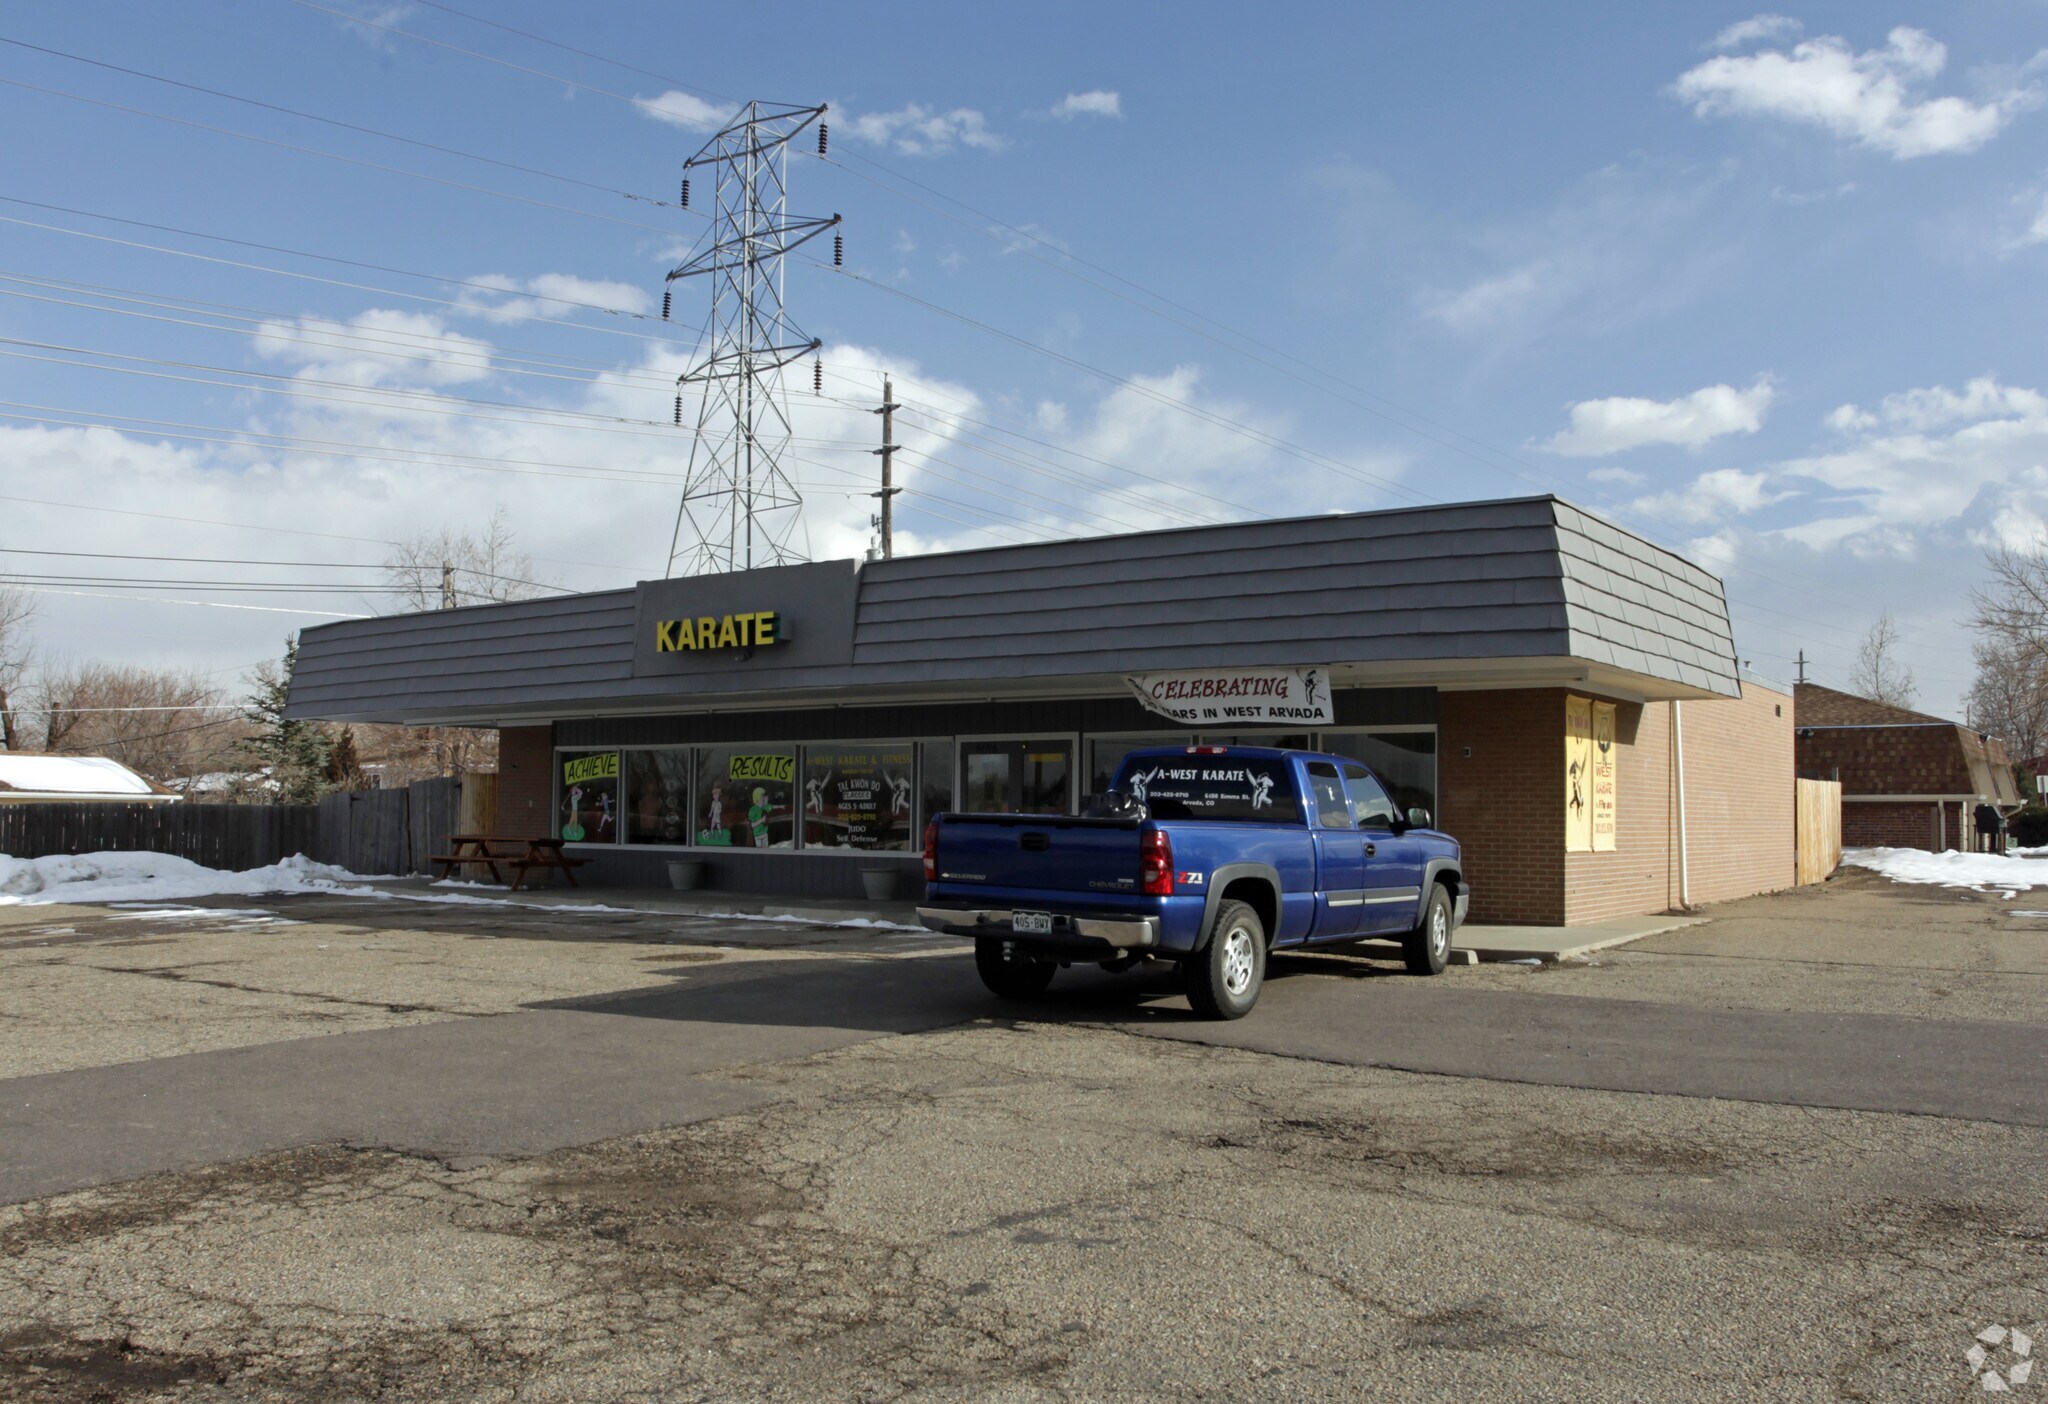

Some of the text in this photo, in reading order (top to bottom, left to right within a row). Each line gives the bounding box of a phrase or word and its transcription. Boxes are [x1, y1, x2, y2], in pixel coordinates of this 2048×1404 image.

[656, 611, 774, 652] KARATE
[1152, 677, 1289, 699] CELEBRATING
[1203, 708, 1218, 718] IN
[1223, 706, 1262, 717] WEST
[1269, 707, 1324, 718] ARVADA
[838, 755, 867, 765] KARATE
[567, 754, 617, 781] ACHIEVE
[731, 756, 793, 780] RESULTS
[1157, 769, 1244, 781] A-WEST KARATE
[837, 779, 881, 792] TAE KWON DO
[1177, 872, 1203, 884] Z71
[1089, 881, 1135, 890] CHEVROLET
